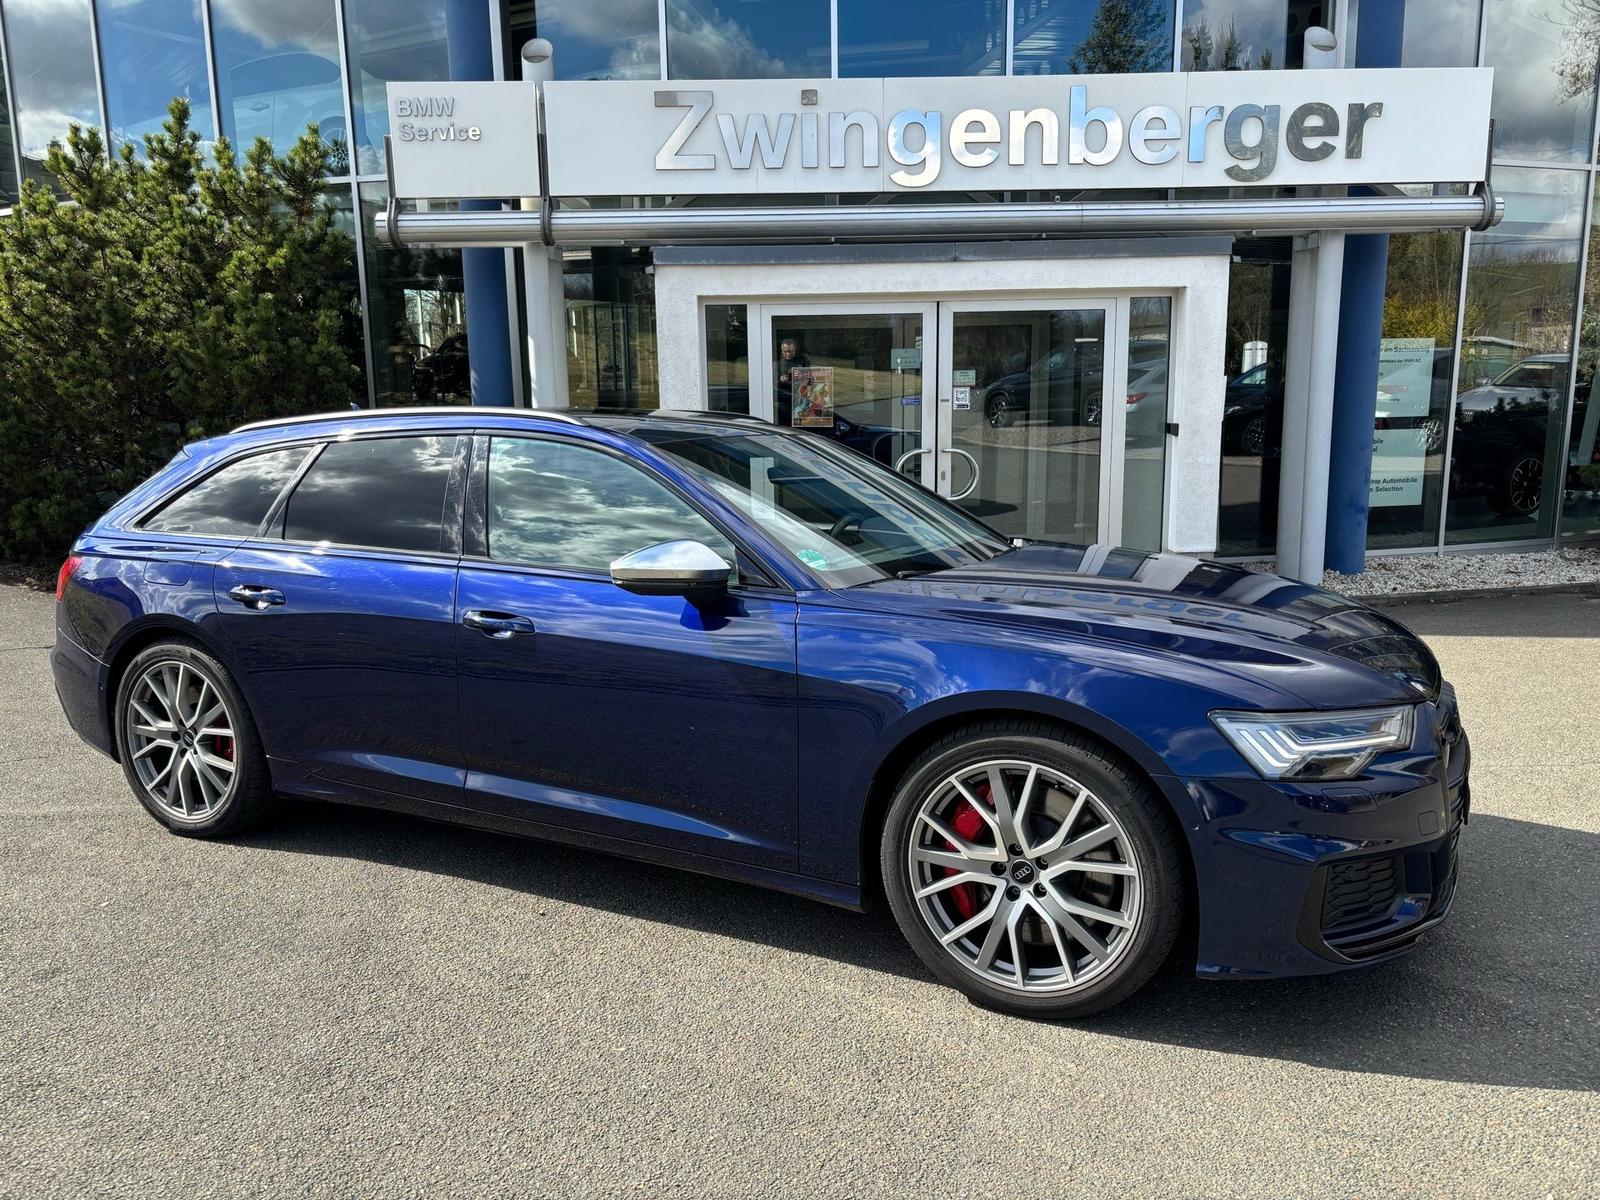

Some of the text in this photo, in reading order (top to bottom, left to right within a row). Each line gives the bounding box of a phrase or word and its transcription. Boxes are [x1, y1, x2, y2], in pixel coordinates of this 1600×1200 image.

[396, 96, 455, 118] BMW
[400, 122, 482, 142] Service
[654, 85, 1383, 187] Zwingenberger
